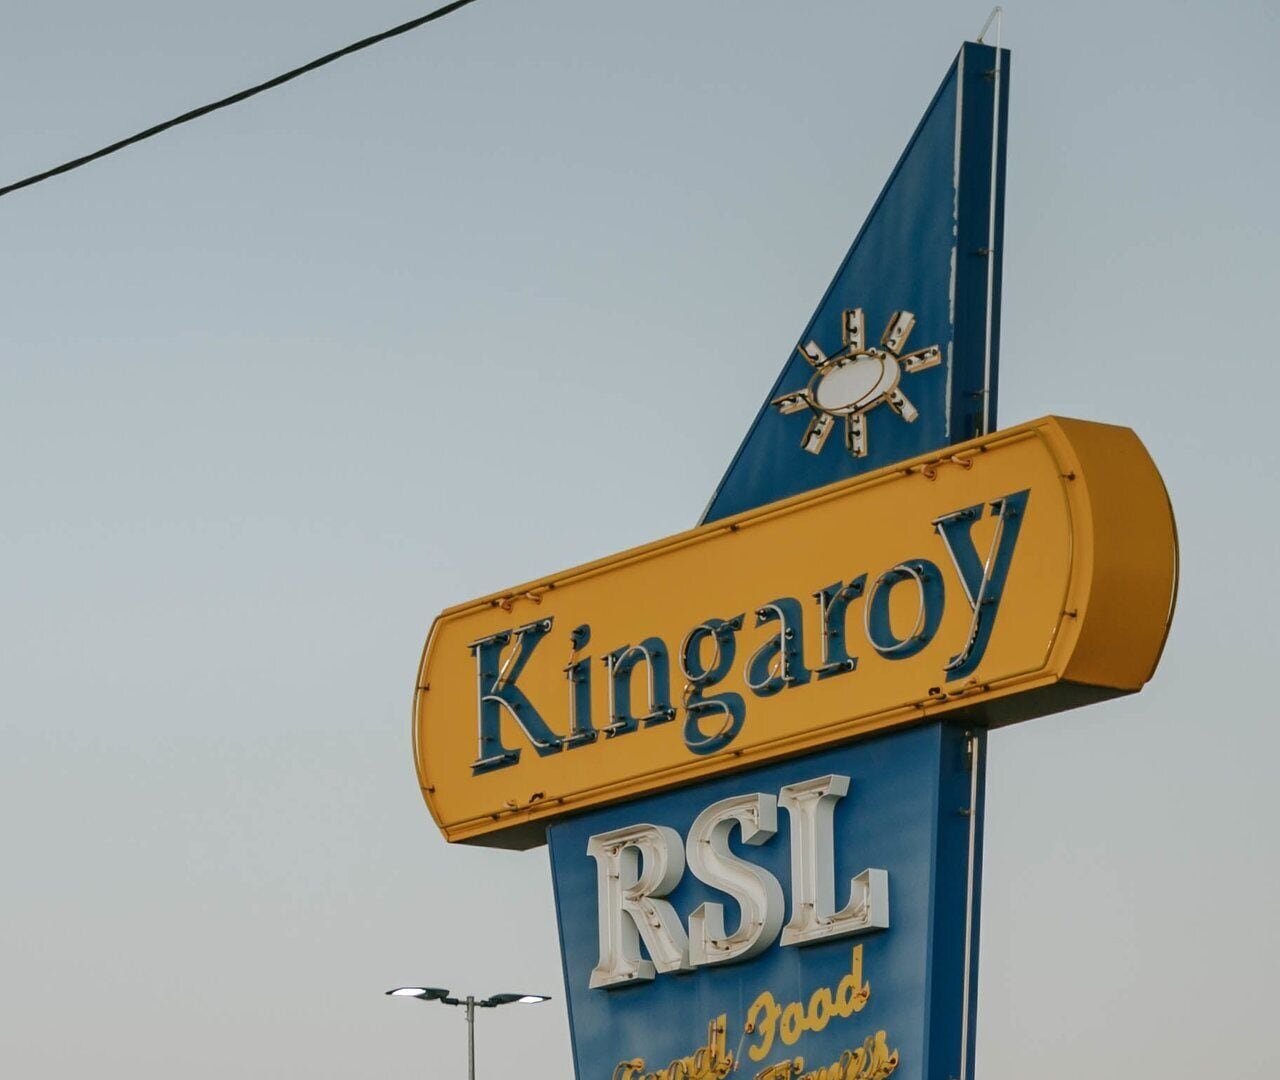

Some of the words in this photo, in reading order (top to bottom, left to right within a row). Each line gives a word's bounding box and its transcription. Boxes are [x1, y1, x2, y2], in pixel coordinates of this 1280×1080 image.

[468, 488, 1031, 776] Kingaroy
[587, 773, 890, 989] RSL
[744, 943, 871, 1062] Food
